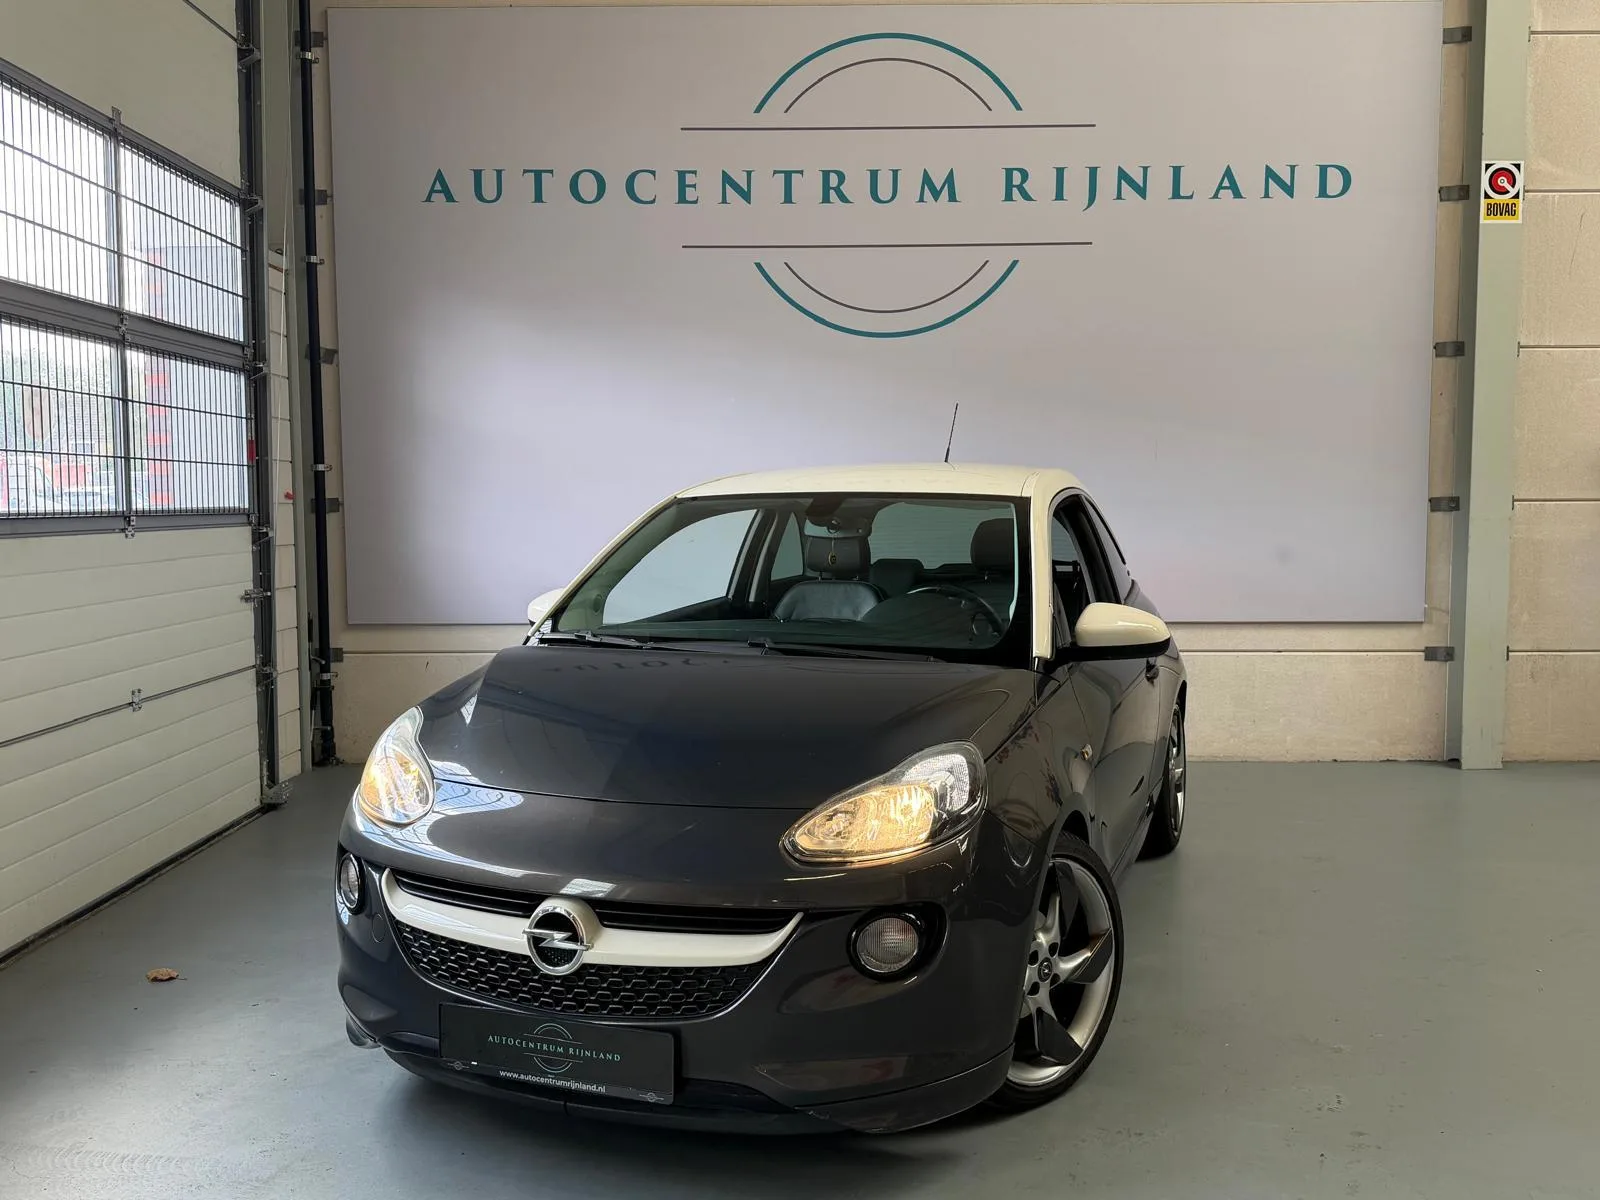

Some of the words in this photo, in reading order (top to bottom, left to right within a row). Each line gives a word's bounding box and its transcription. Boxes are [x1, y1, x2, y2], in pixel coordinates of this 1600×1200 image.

[421, 167, 961, 205] AUTOCENTRUM
[1001, 163, 1352, 212] RIJNLAND
[1486, 202, 1517, 217] BOVAG
[487, 1034, 564, 1053] AUTOCENTRUM
[568, 1047, 621, 1062] RIJNLAND
[499, 1070, 606, 1093] www.autocentrumrijnland.nl
